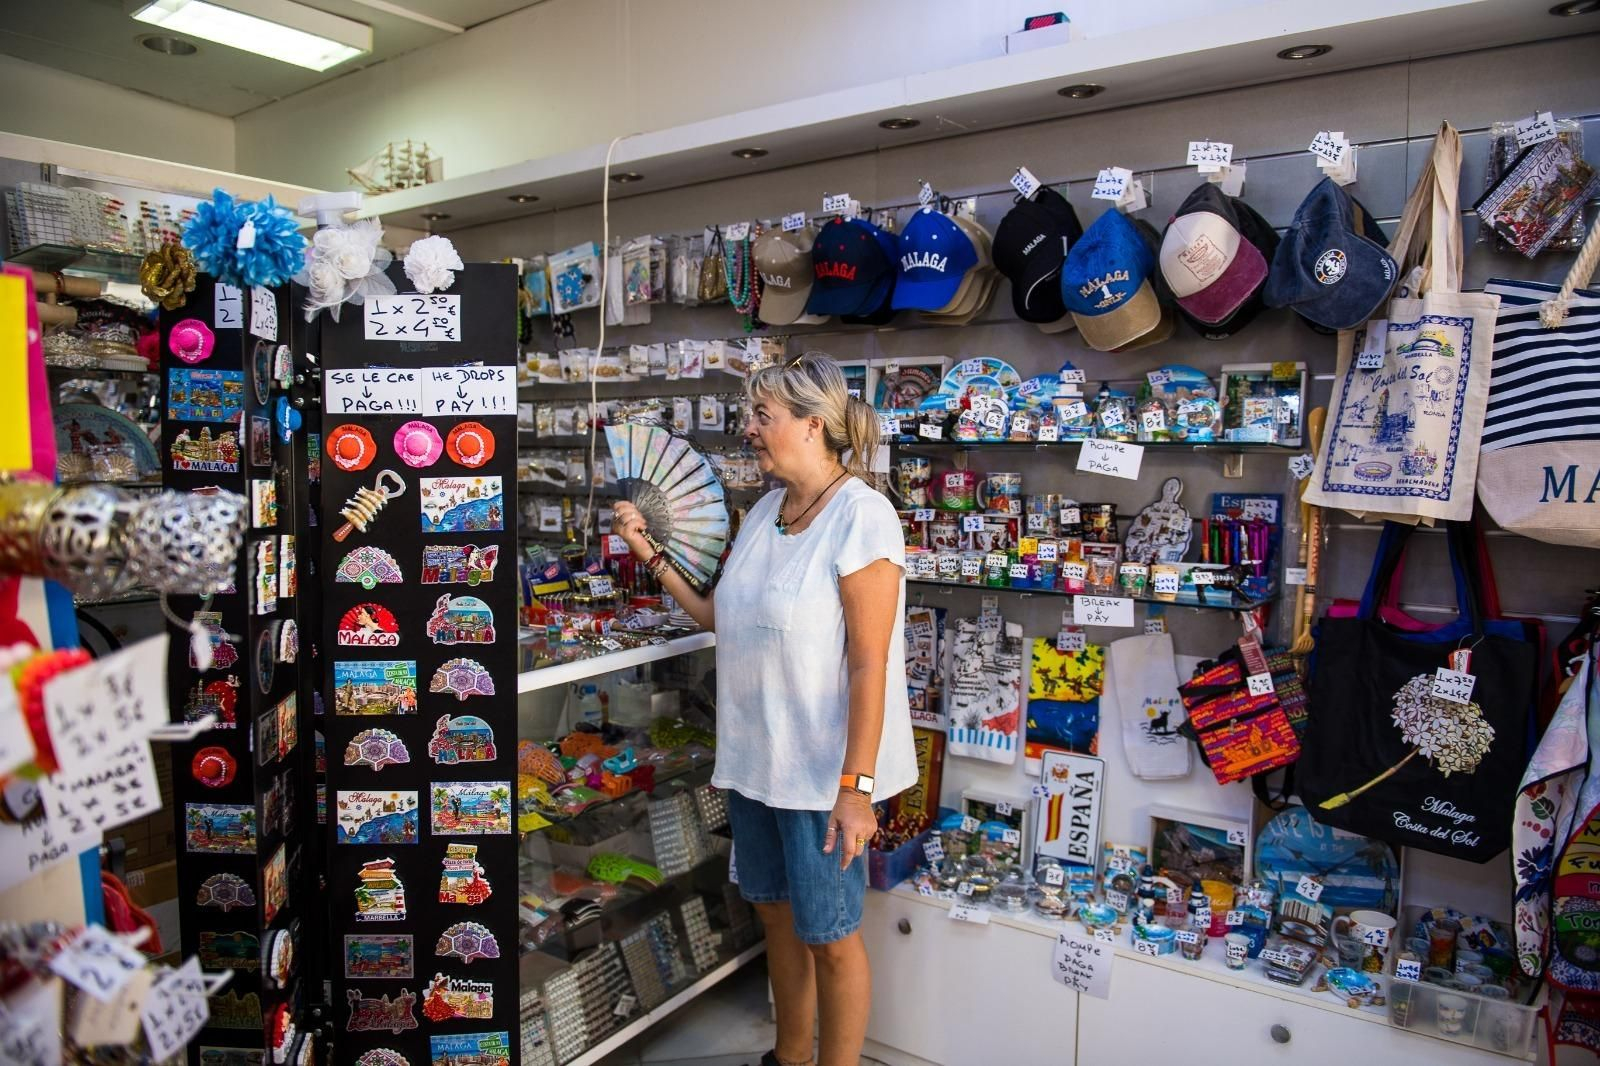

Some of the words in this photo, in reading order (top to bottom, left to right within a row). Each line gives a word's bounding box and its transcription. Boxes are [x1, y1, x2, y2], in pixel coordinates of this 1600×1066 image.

[1021, 233, 1047, 256] MALAGA
[900, 250, 949, 273] MALAGA
[815, 260, 858, 281] MALAGA
[331, 372, 356, 384] SE
[362, 372, 381, 384] LE
[386, 372, 415, 383] CAE
[432, 370, 453, 382] HE
[456, 368, 505, 384] DROPS
[1410, 364, 1435, 384] Sol
[341, 425, 367, 437] MALAGA
[407, 423, 433, 433] MALAGA
[452, 423, 477, 435] MALAGA
[191, 461, 236, 472] MALAGA
[1088, 460, 1119, 473] PAGA
[1081, 596, 1121, 607] BREAK
[1087, 613, 1110, 624] PAY
[338, 631, 398, 646] MALAGA
[341, 671, 378, 679] MALAGA
[1068, 771, 1096, 859] ESPAÑA
[1420, 796, 1477, 824] Malaga
[1393, 811, 1429, 834] Costa
[1429, 825, 1449, 840] del
[1450, 829, 1481, 848] Sol
[451, 980, 491, 993] Malaga
[437, 1042, 472, 1052] MALAGA
